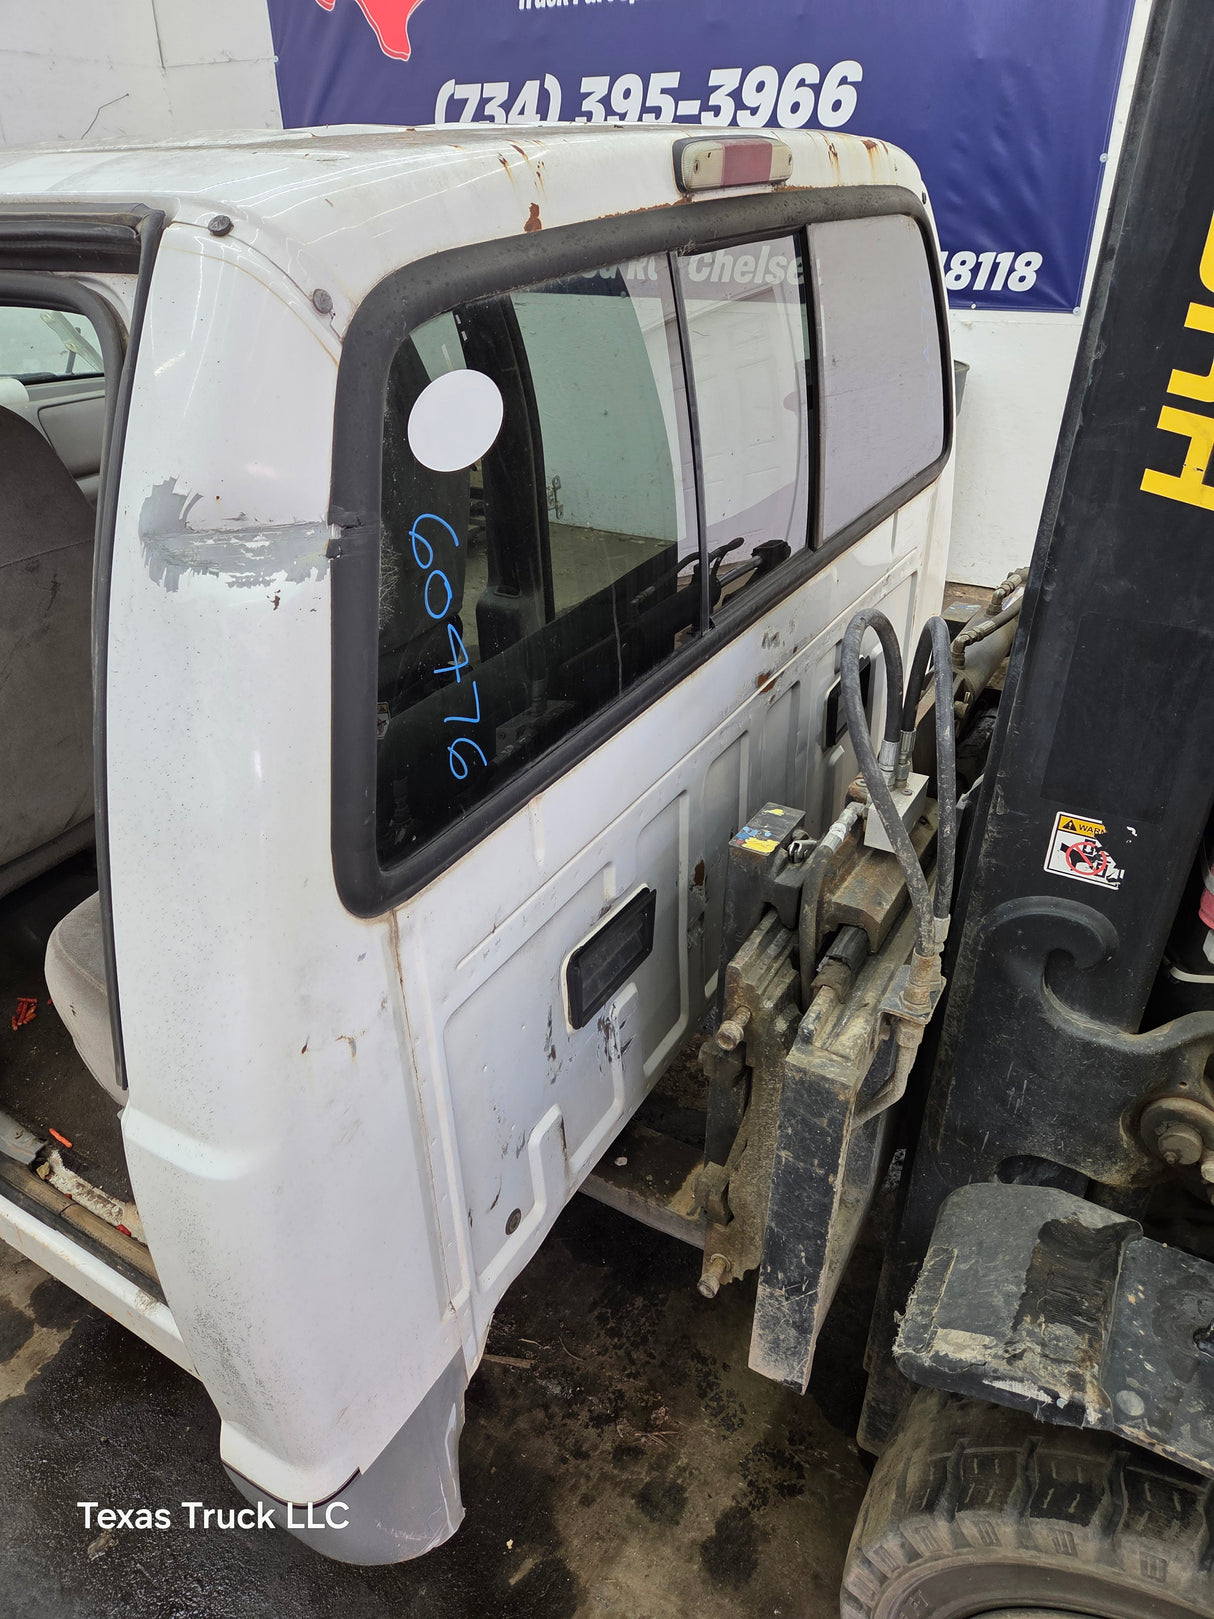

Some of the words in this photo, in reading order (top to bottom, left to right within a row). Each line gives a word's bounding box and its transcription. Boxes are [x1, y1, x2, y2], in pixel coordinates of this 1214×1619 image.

[434, 73, 562, 125] (734)
[575, 60, 863, 129] 395-3966
[687, 245, 822, 285] Chelse
[408, 513, 488, 780] 60476
